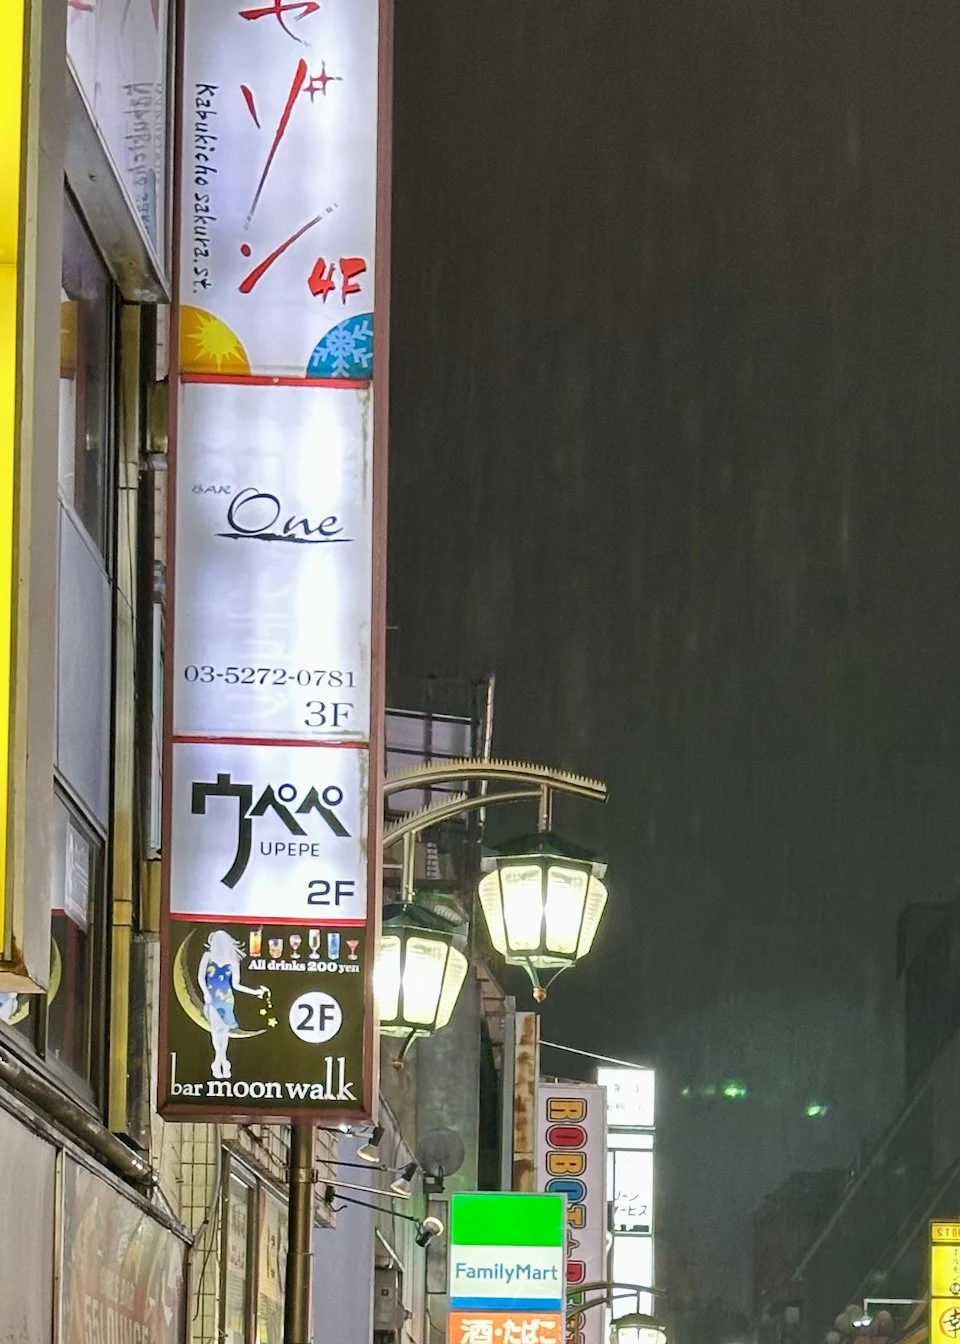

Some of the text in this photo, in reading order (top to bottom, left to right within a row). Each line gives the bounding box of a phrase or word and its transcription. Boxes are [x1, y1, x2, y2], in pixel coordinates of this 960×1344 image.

[307, 257, 367, 304] 4F
[227, 487, 345, 537] One
[184, 664, 357, 689] 03-5272-0781
[304, 701, 356, 728] 3F
[260, 841, 320, 858] UPEPE
[307, 879, 355, 906] 2F
[248, 960, 359, 976] All drinks 200 yen
[295, 1004, 336, 1032] 2F
[170, 1052, 358, 1101] bar moon walk
[455, 1262, 559, 1284] FamilyMart
